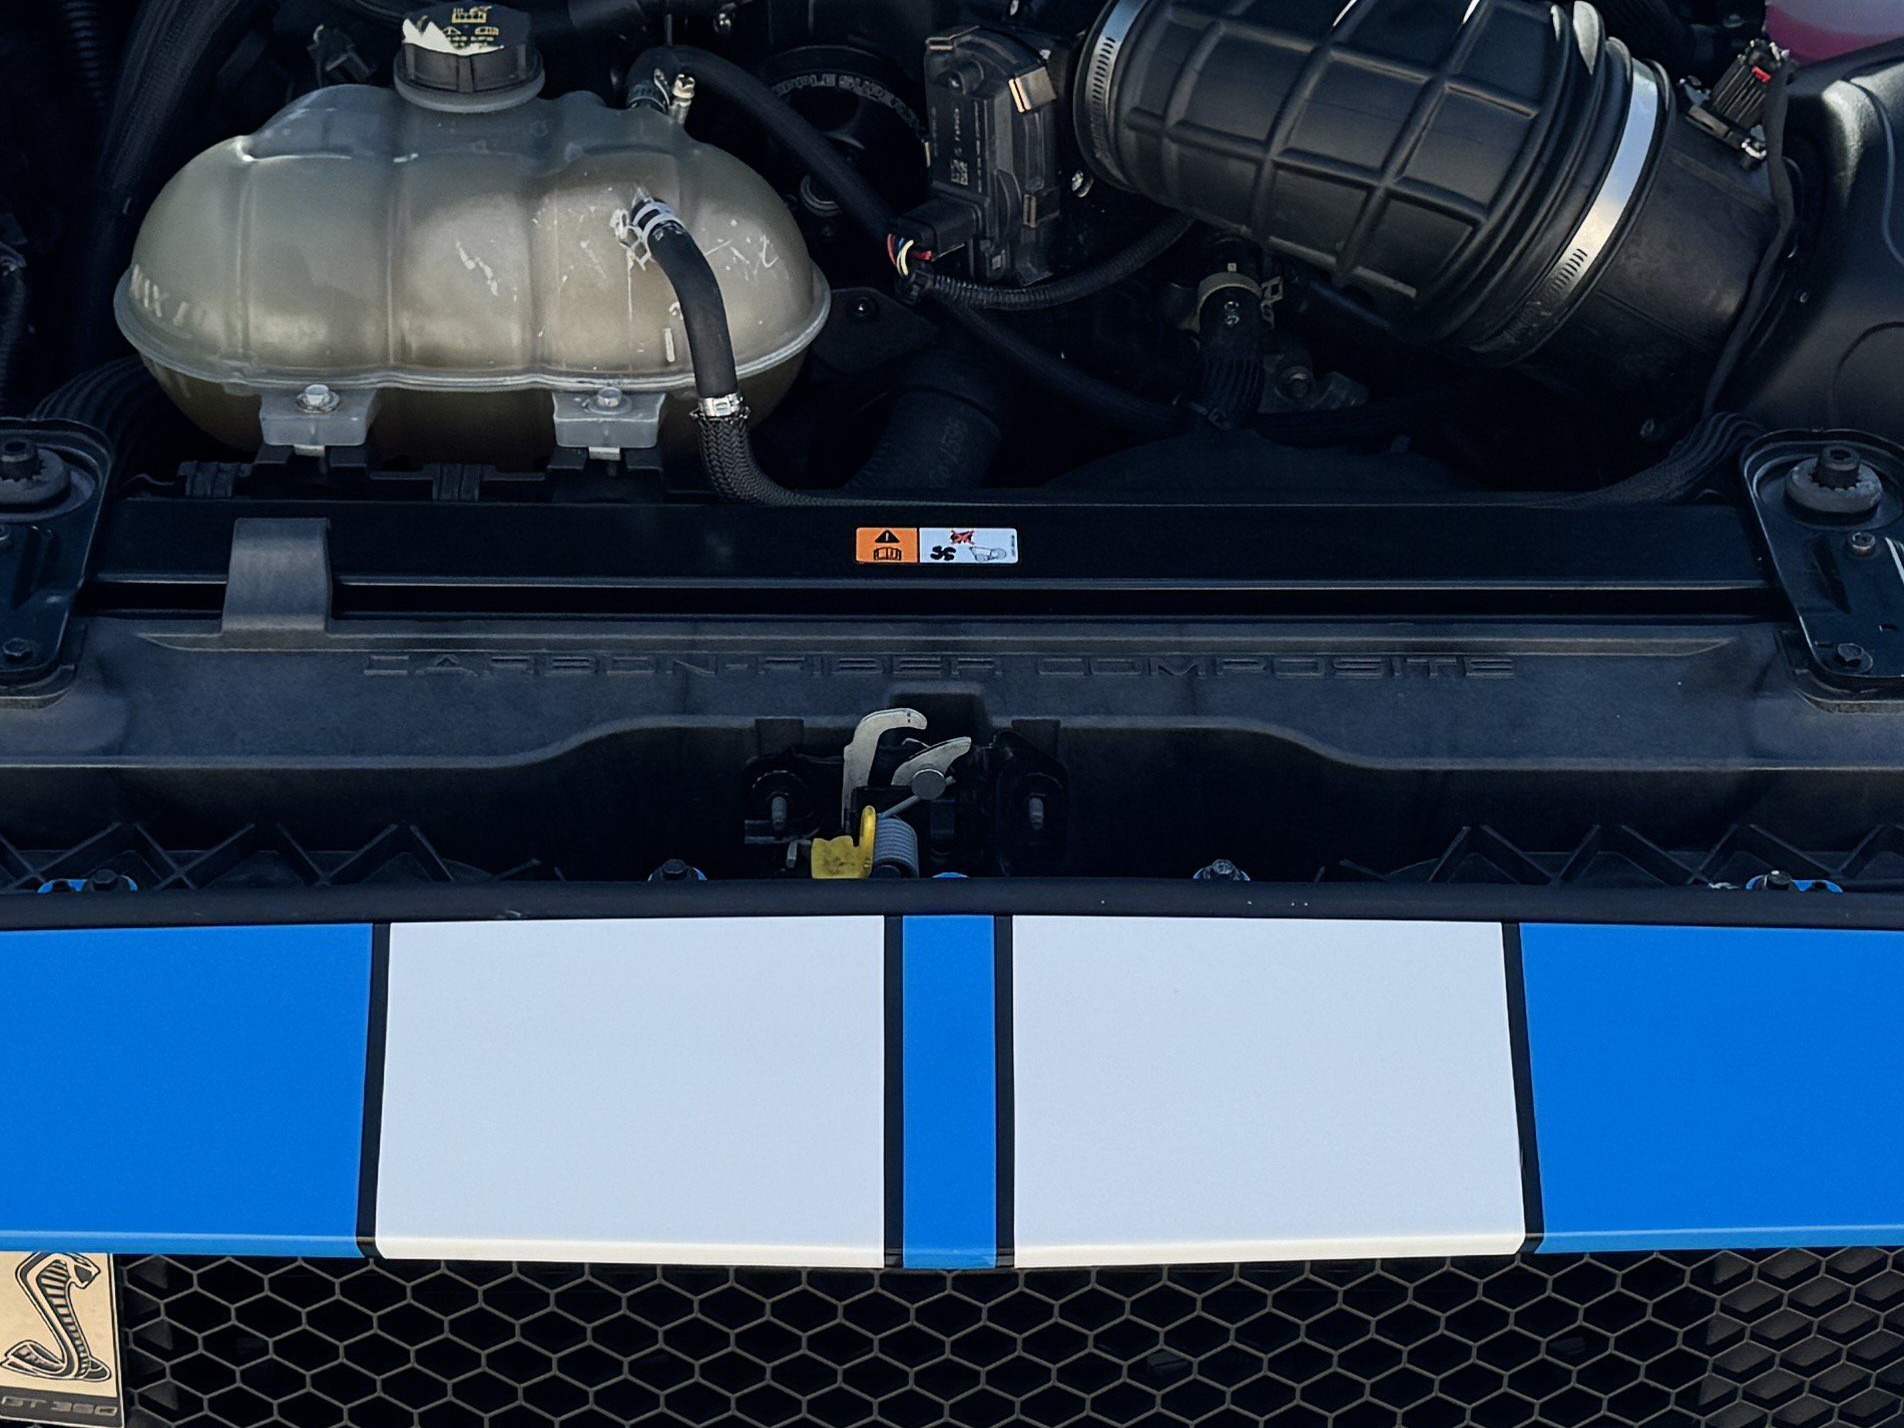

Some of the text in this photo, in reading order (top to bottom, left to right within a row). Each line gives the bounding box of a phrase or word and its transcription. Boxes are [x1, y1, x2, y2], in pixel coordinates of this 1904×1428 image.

[1038, 656, 1515, 678] COMPOSITE
[1, 1395, 118, 1416] GT 350
